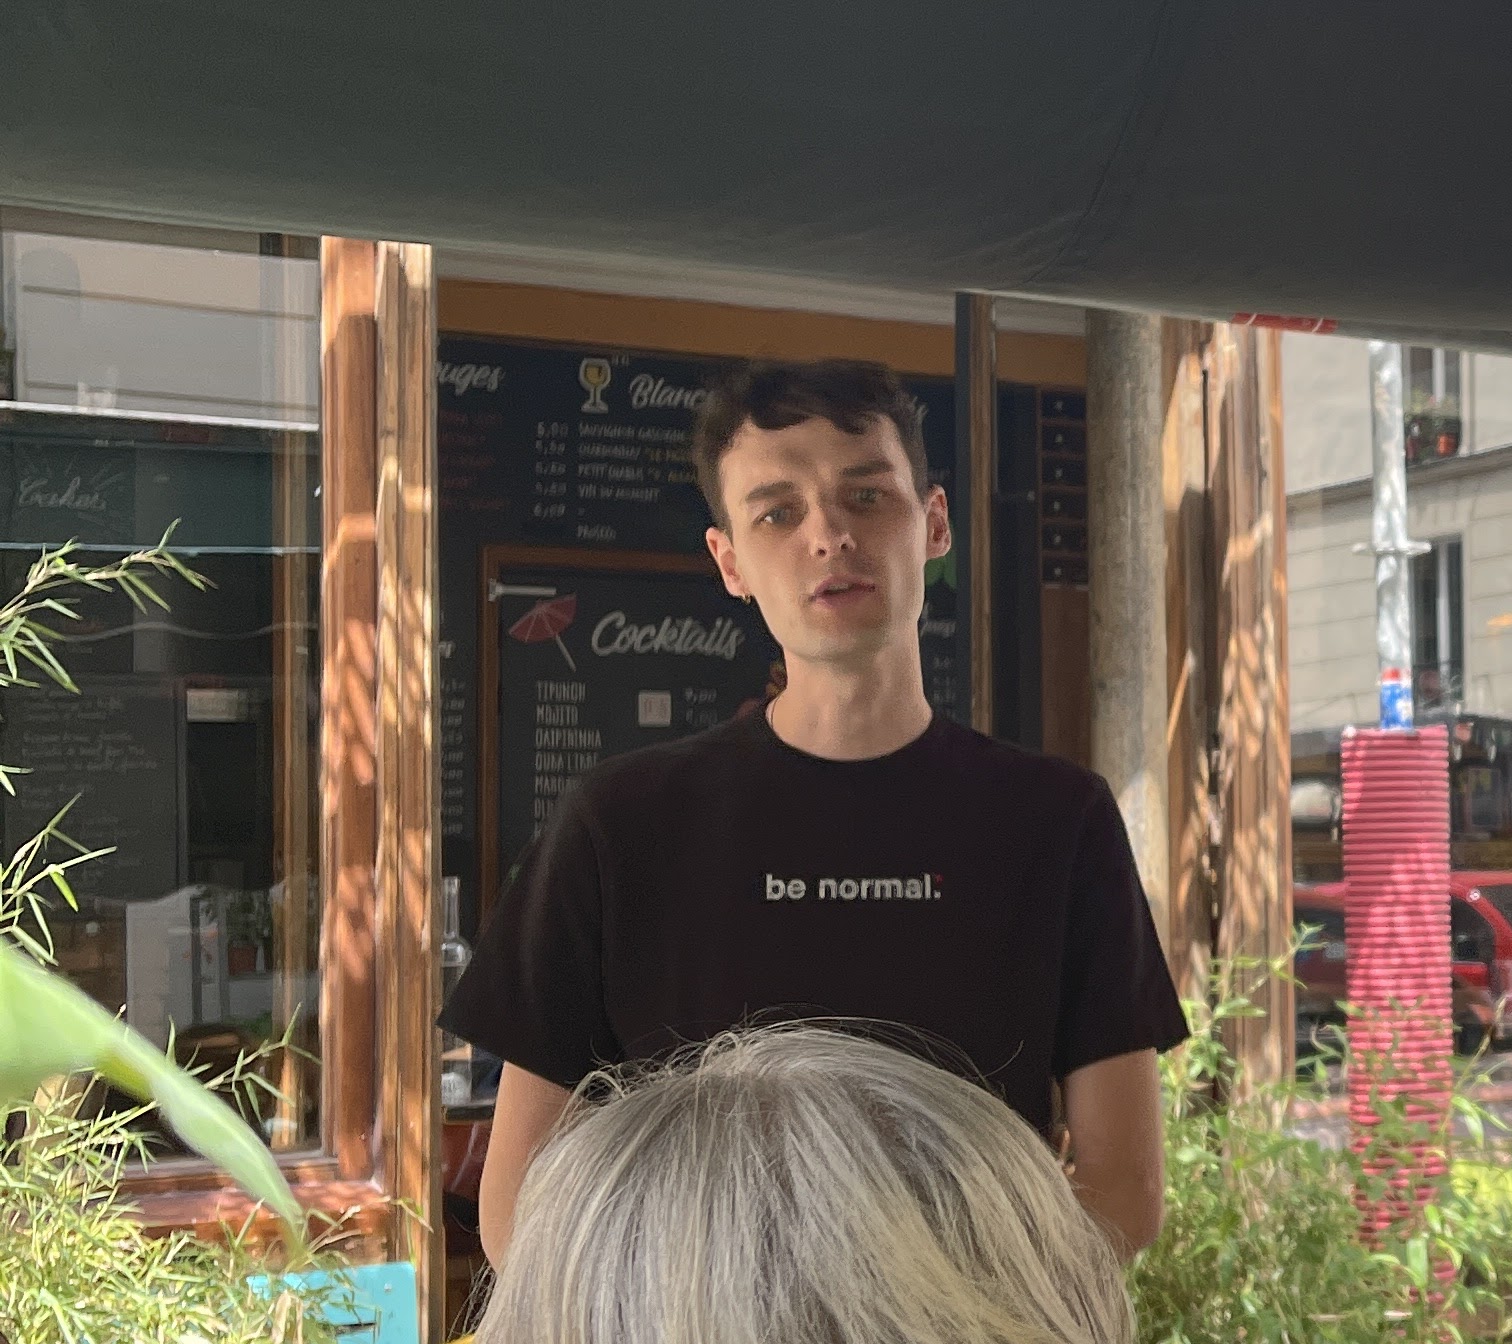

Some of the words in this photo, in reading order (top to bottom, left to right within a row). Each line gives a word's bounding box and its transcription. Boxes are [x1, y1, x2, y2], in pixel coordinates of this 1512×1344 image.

[591, 609, 746, 661] Cocktails
[765, 873, 807, 900] be
[818, 873, 942, 901] normal.
